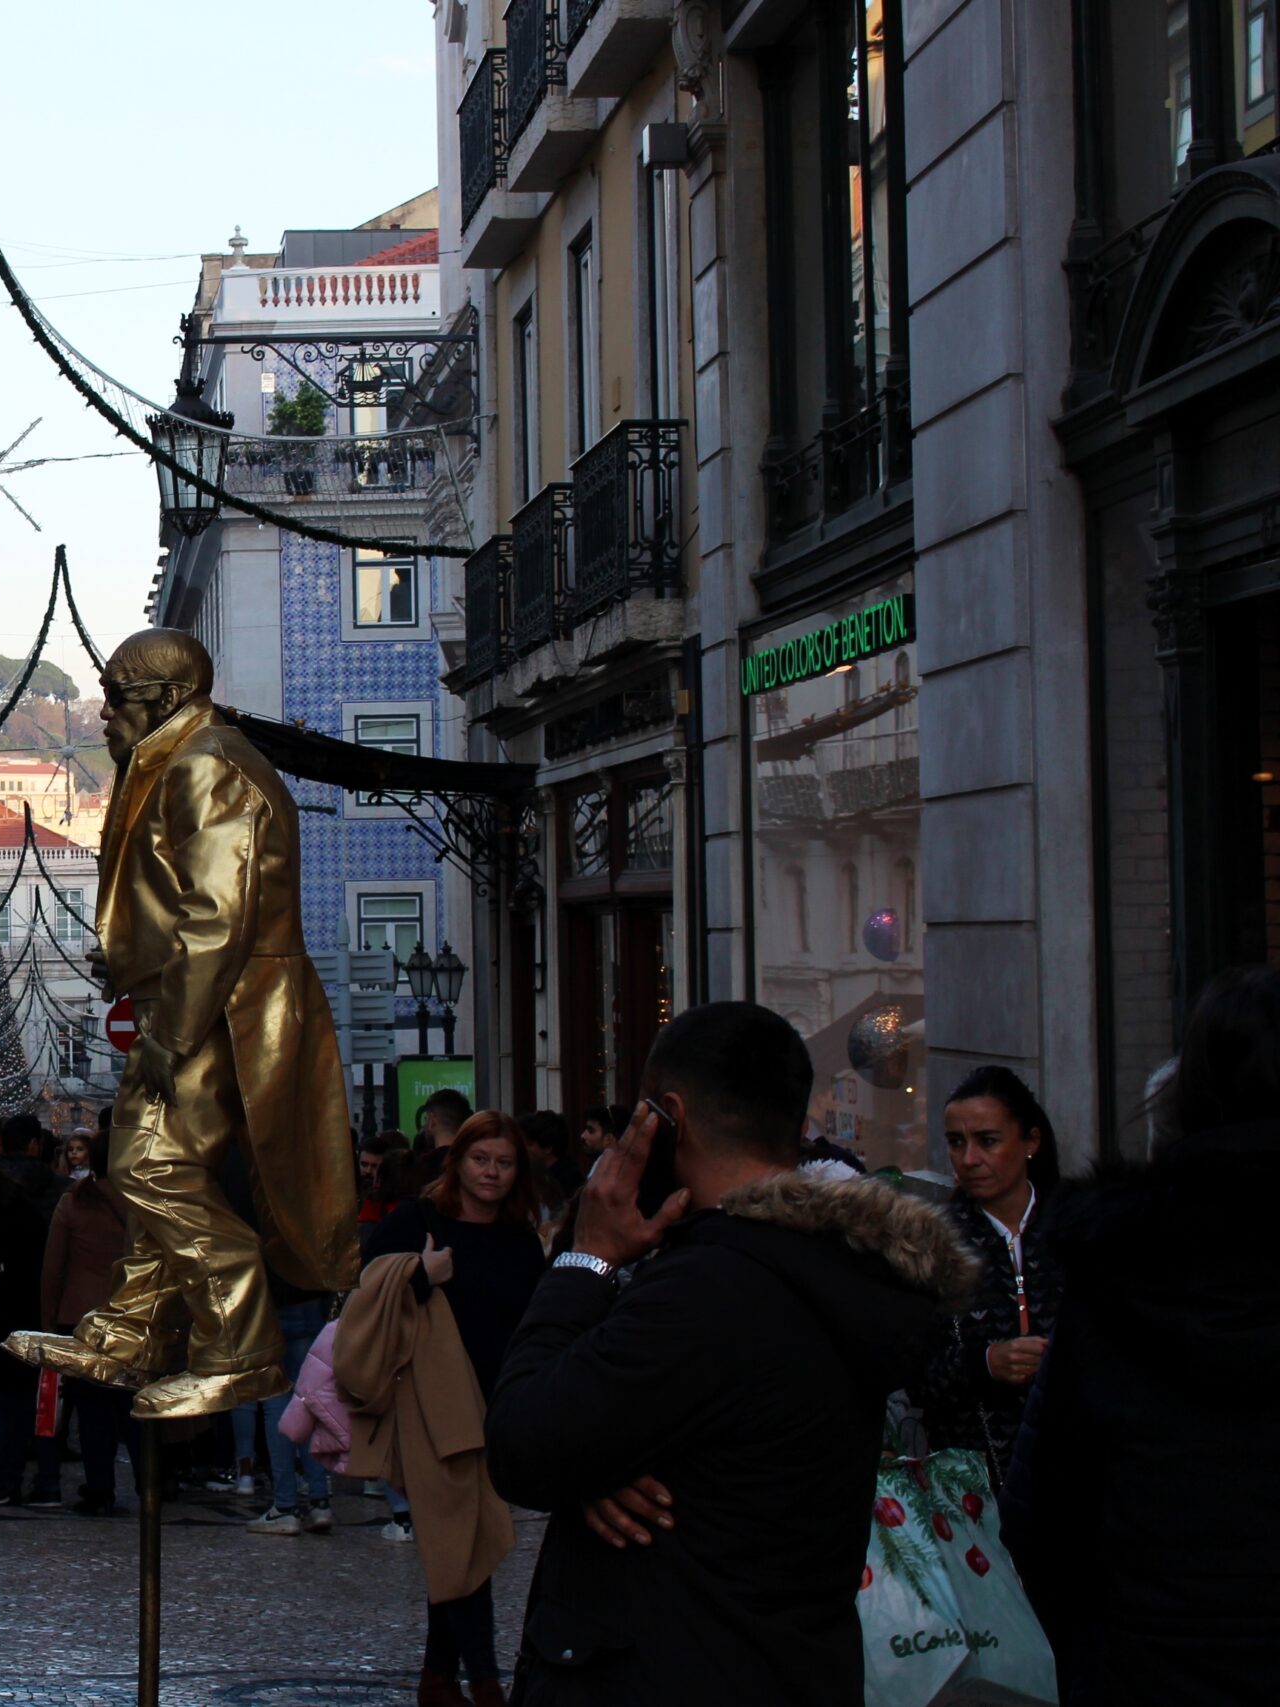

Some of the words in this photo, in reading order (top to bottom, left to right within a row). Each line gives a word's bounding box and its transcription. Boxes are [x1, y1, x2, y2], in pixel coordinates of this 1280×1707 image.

[741, 648, 777, 695] UNITED
[779, 630, 820, 683] COLORS
[823, 620, 839, 667] OF
[841, 594, 907, 661] BENETTON.
[414, 1080, 434, 1097] i'm
[889, 1634, 914, 1658] El
[912, 1628, 963, 1653] Corte
